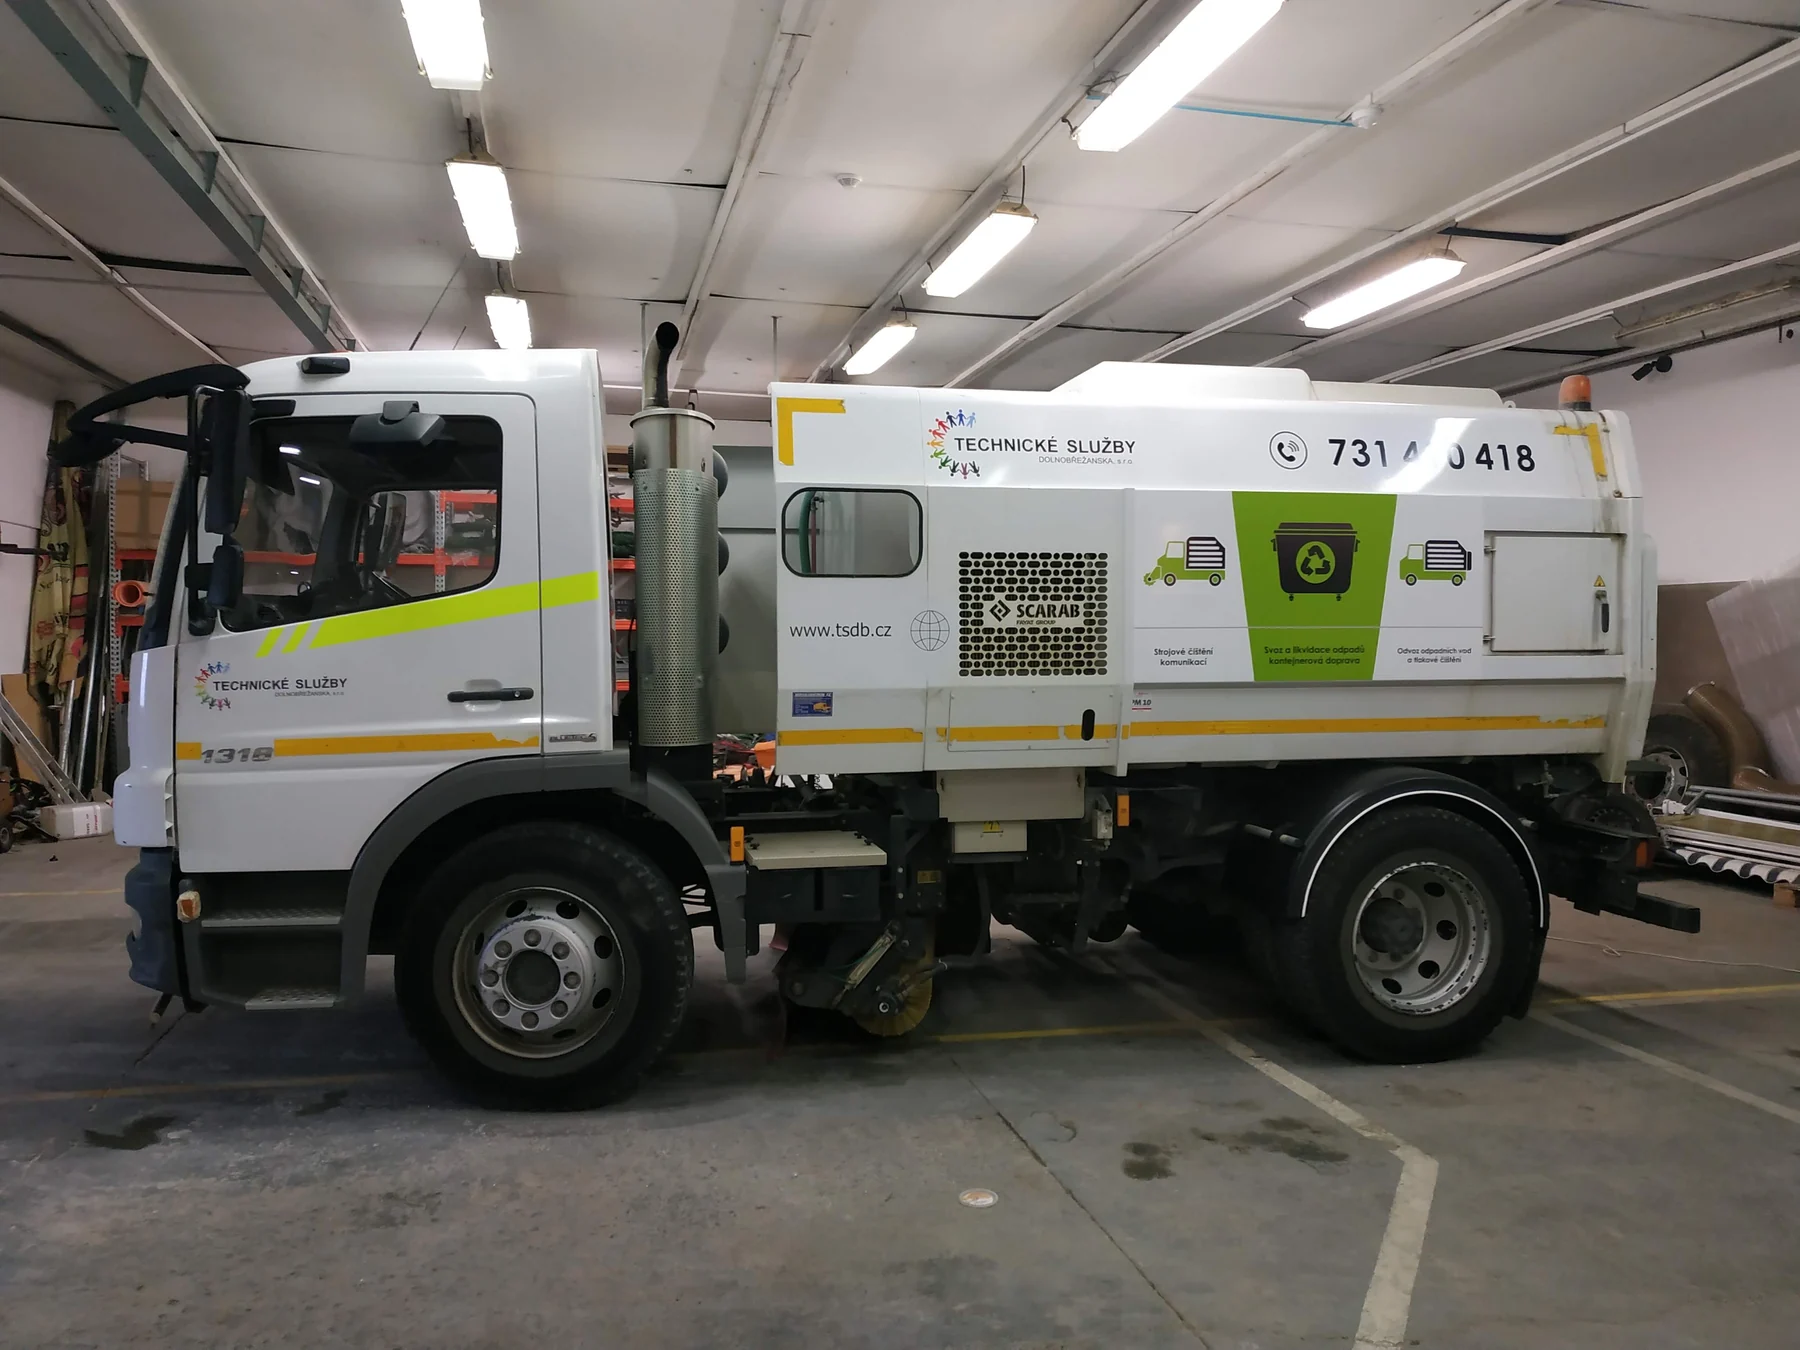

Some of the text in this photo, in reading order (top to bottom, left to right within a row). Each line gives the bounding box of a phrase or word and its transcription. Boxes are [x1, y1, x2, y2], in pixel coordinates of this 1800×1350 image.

[954, 436, 1136, 454] TECHNICKÉ SLUŽBY
[1328, 439, 1536, 472] 731 40 418
[1016, 604, 1080, 618] SCARAB
[789, 622, 892, 637] www.tsdb.cz
[1154, 648, 1186, 657] Strojové
[1264, 646, 1283, 654] Svoz
[1332, 645, 1365, 655] odpadů
[1160, 658, 1207, 666] komunikací
[1269, 656, 1360, 666] kontejnerová doprava
[213, 676, 348, 692] TECHNICKÉ SLUŽBY
[201, 746, 274, 764] 1318
